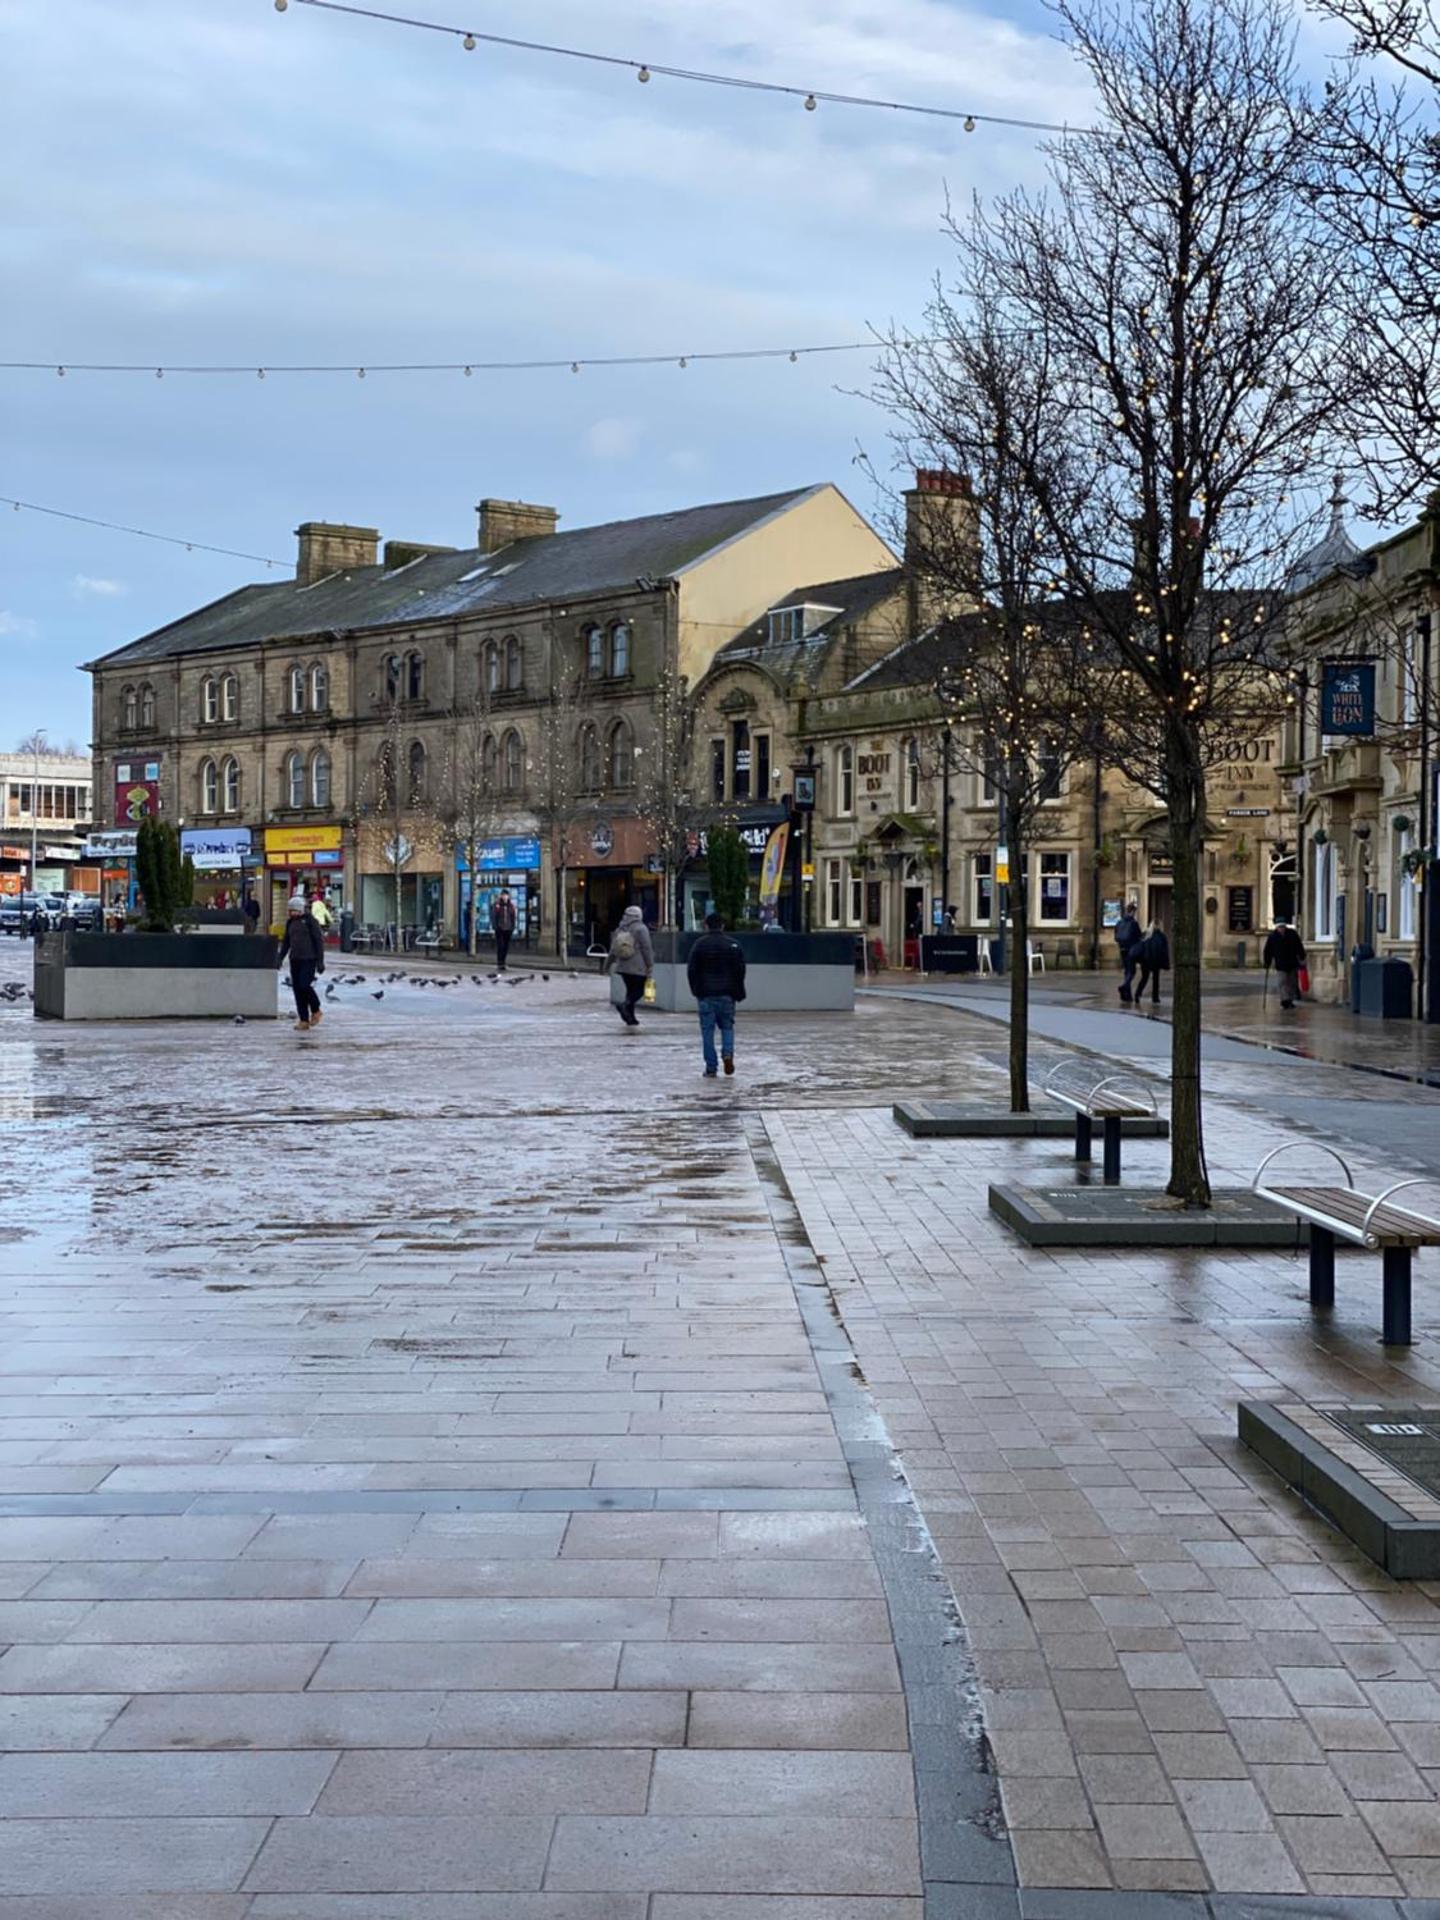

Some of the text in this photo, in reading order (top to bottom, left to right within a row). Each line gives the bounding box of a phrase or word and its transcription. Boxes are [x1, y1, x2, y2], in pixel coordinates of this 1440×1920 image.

[1332, 693, 1361, 706] WHITE
[1332, 706, 1363, 726] LION
[1208, 739, 1275, 762] BOOT
[858, 753, 892, 775] BOOT
[1227, 765, 1255, 781] INN
[866, 777, 882, 791] INN
